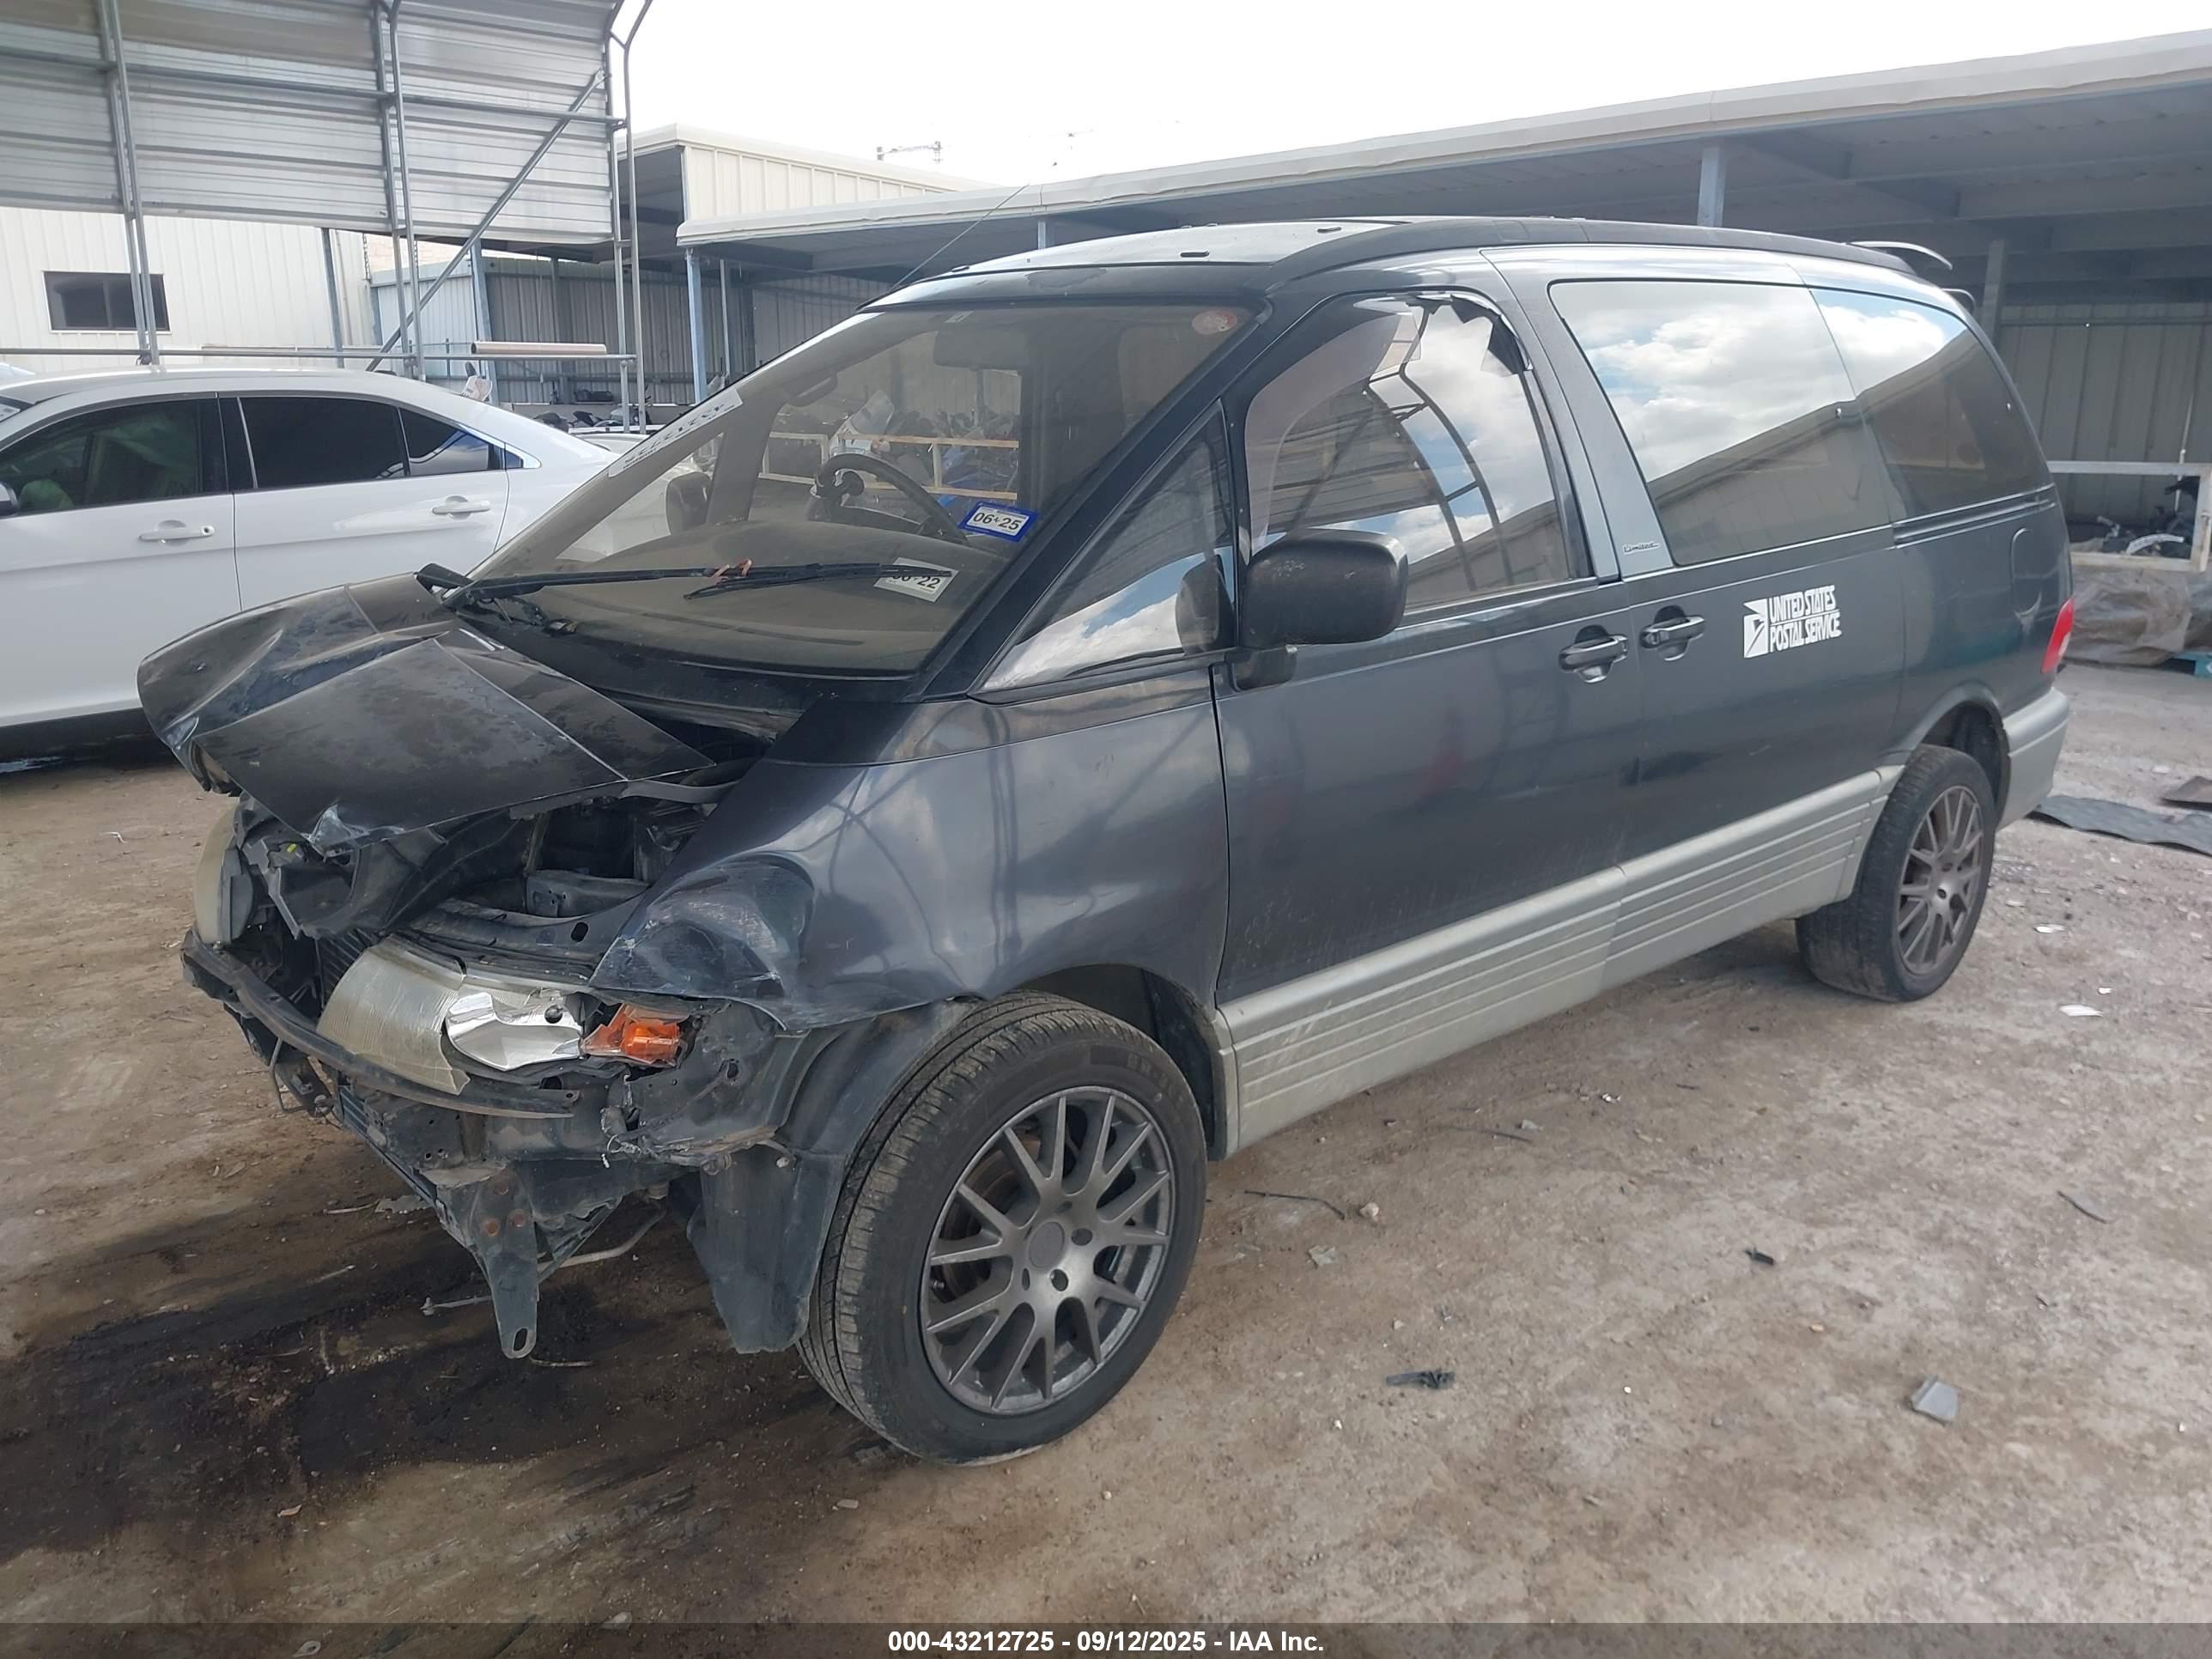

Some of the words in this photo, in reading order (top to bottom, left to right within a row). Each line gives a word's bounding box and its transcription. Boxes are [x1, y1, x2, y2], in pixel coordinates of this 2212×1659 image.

[1769, 592, 1804, 623] UNITED
[1804, 585, 1836, 616] STATES
[1770, 623, 1804, 653] POSTAL
[1804, 611, 1842, 644] SERVICE
